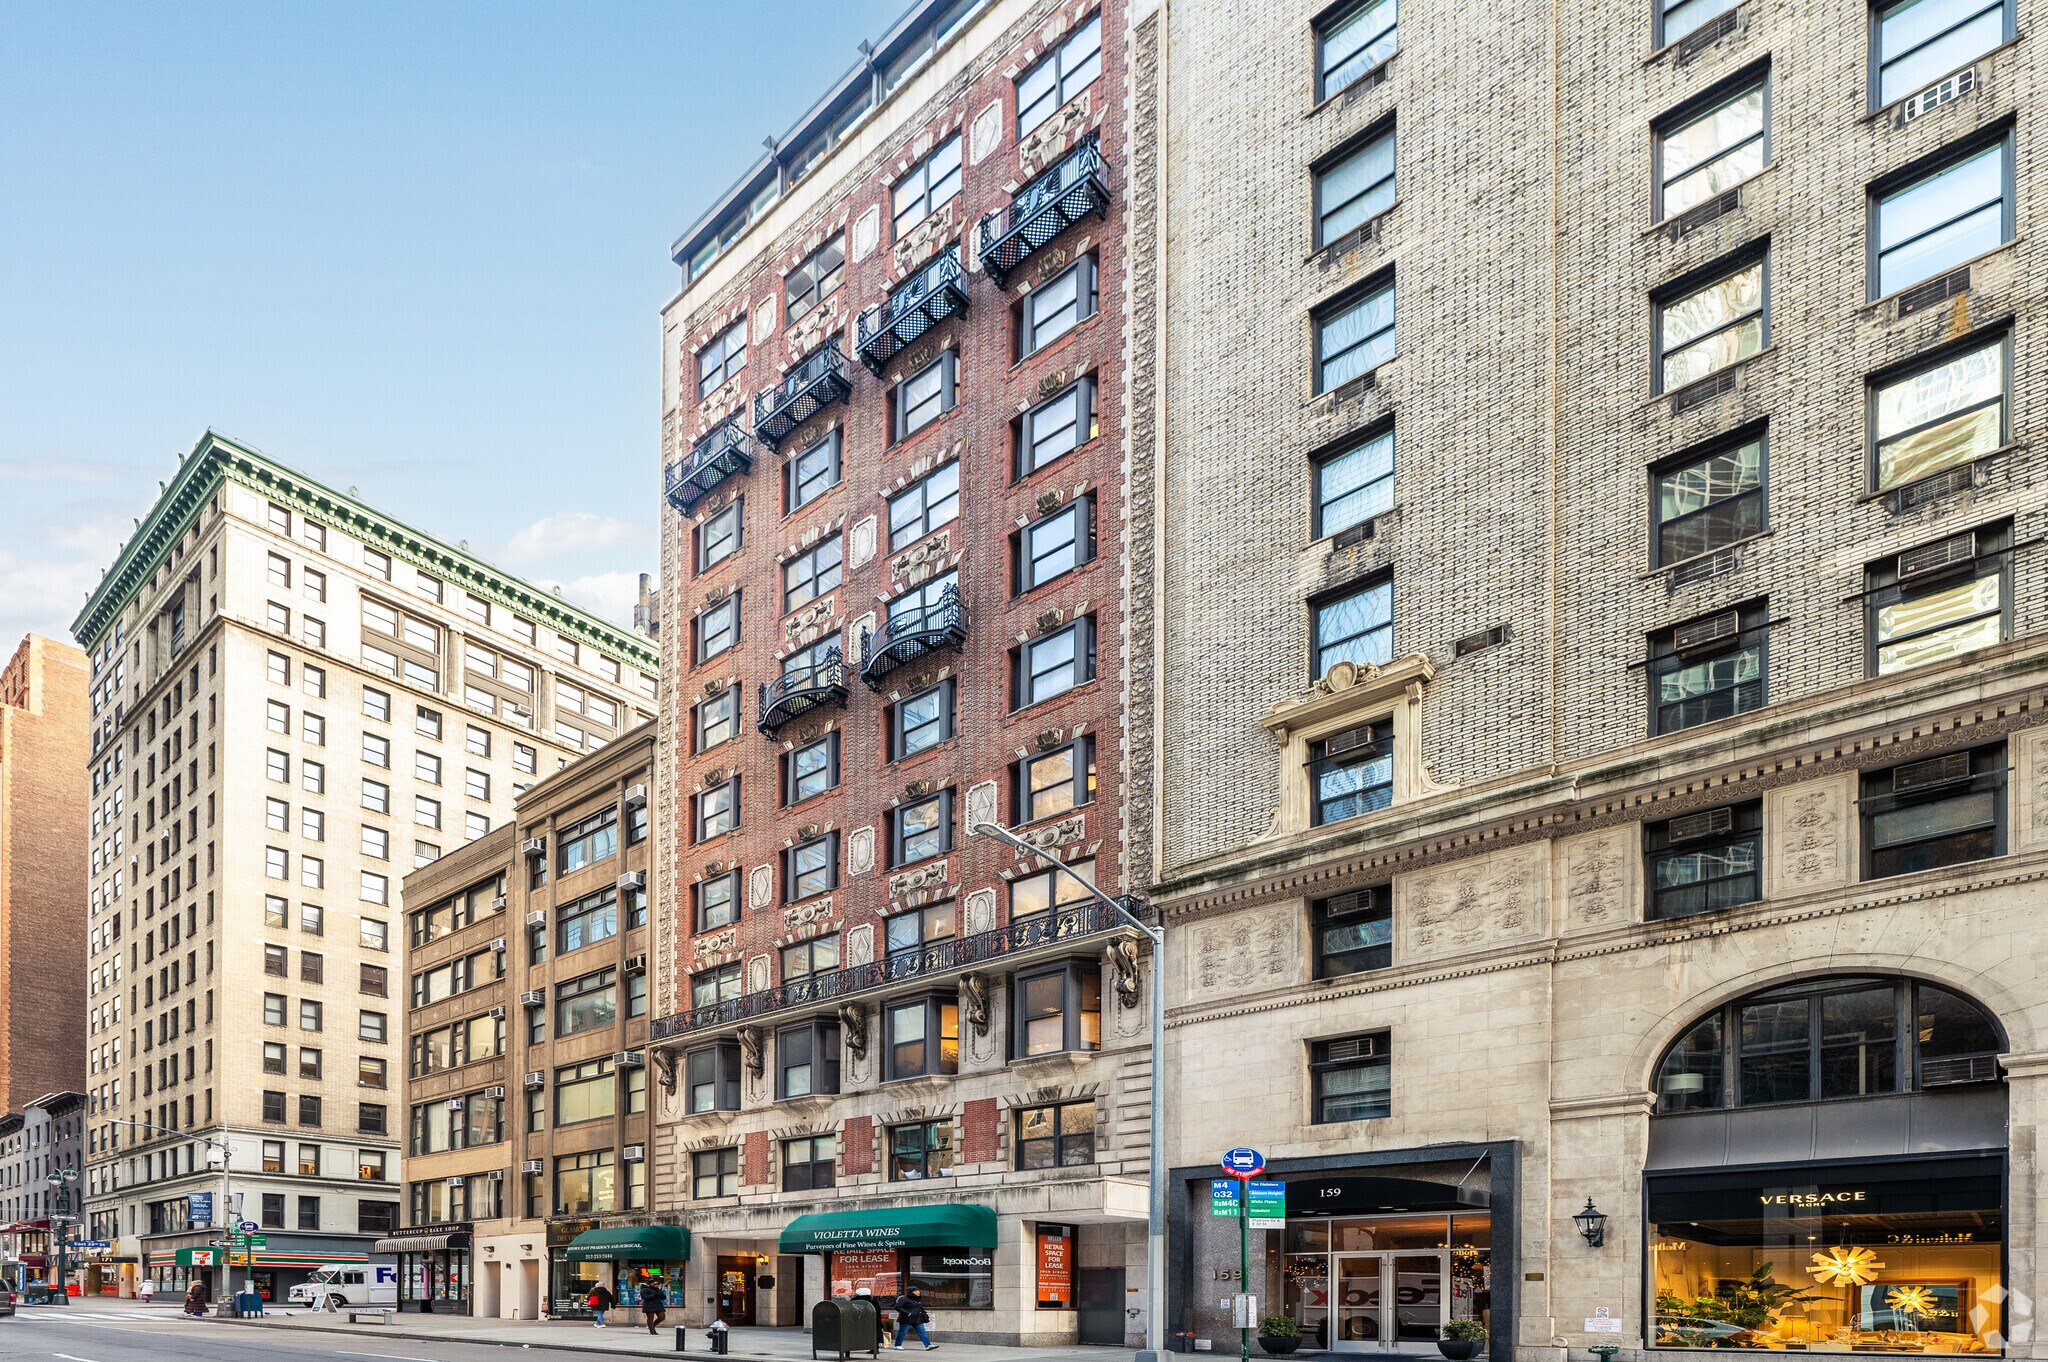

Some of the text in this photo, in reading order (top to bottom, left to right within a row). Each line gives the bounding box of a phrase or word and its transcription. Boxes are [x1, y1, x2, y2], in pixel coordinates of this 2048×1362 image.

[1235, 1168, 1262, 1177] STANDING
[1213, 1181, 1228, 1189] M4
[1213, 1190, 1233, 1198] Q32
[1319, 1187, 1341, 1199] 159
[1760, 1191, 1867, 1205] VERSACE
[1213, 1199, 1239, 1207] BxM4C
[1213, 1208, 1237, 1216] BxM11
[814, 1228, 900, 1240] VIOLETTA WINES
[805, 1243, 834, 1251] Purveyors
[840, 1254, 890, 1264] FOR LEASE
[1212, 1269, 1242, 1281] 159
